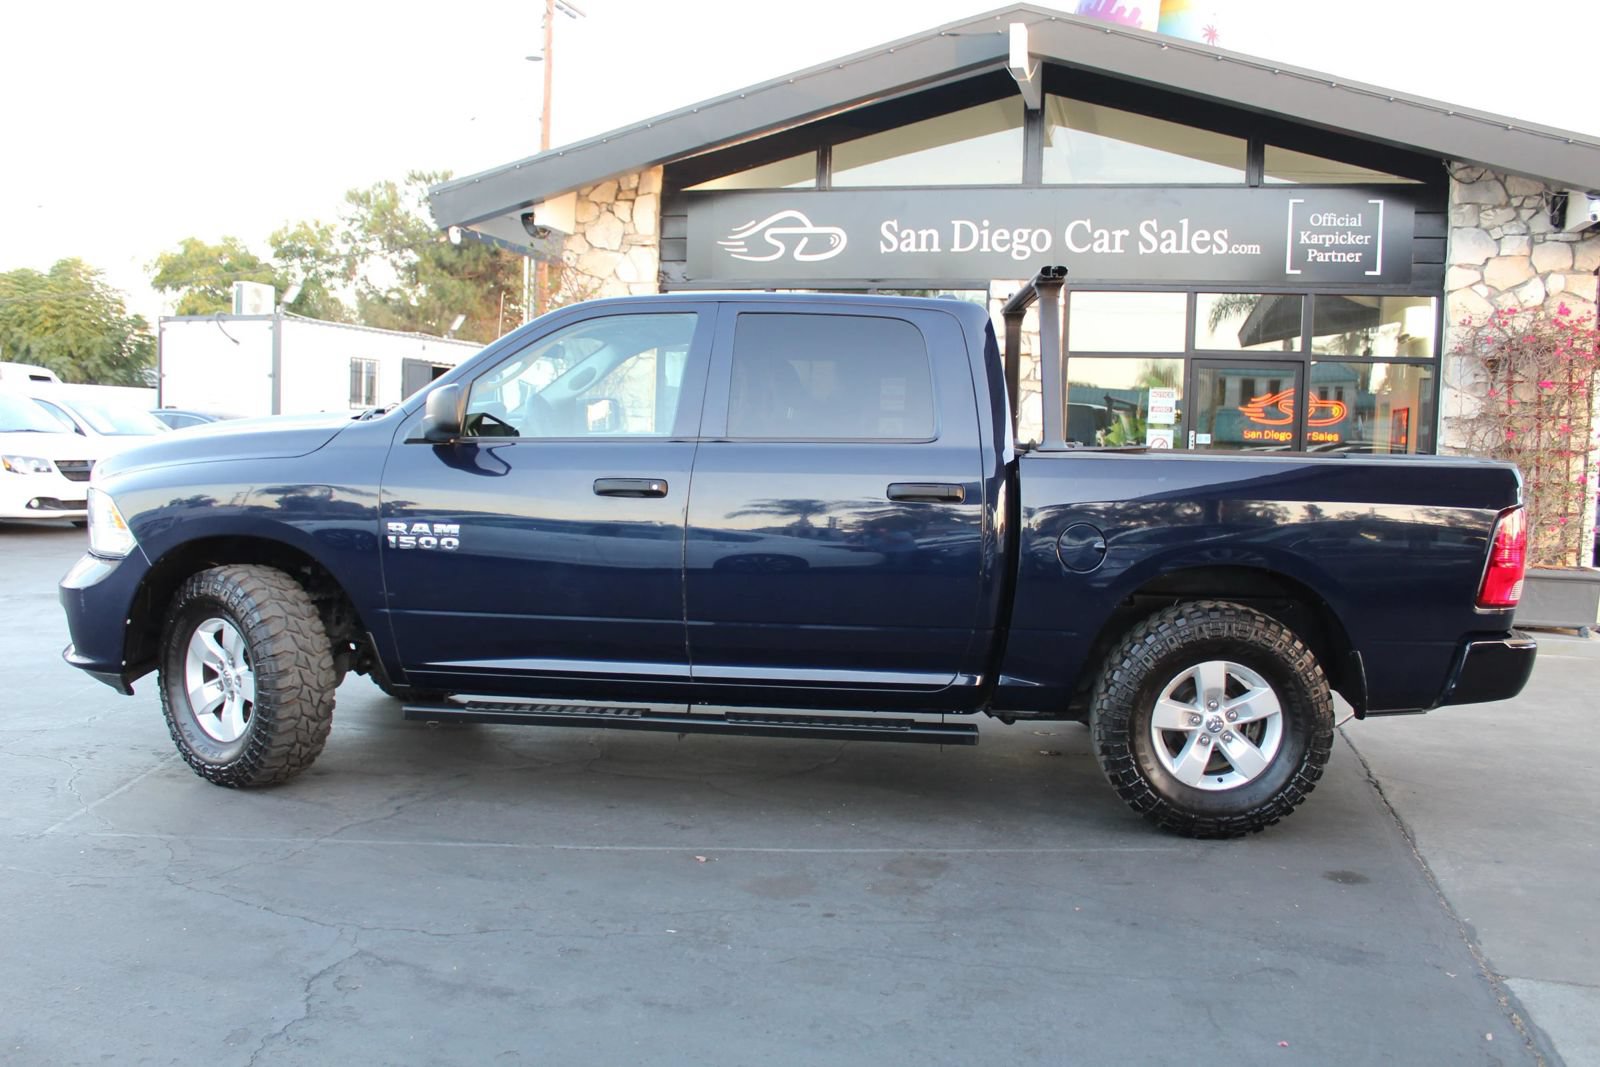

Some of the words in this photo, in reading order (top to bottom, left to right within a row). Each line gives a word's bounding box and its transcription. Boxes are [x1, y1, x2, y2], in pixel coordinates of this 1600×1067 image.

[1309, 212, 1362, 227] Official
[880, 219, 942, 254] San
[950, 219, 1053, 260] Diego
[1064, 218, 1130, 253] Car
[1299, 230, 1372, 247] Karpicker
[1306, 248, 1363, 262] Partner
[1243, 430, 1262, 440] San
[1264, 430, 1293, 441] Diego
[1311, 431, 1339, 441] Sales
[387, 522, 460, 537] RAM
[387, 535, 460, 551] 1500
